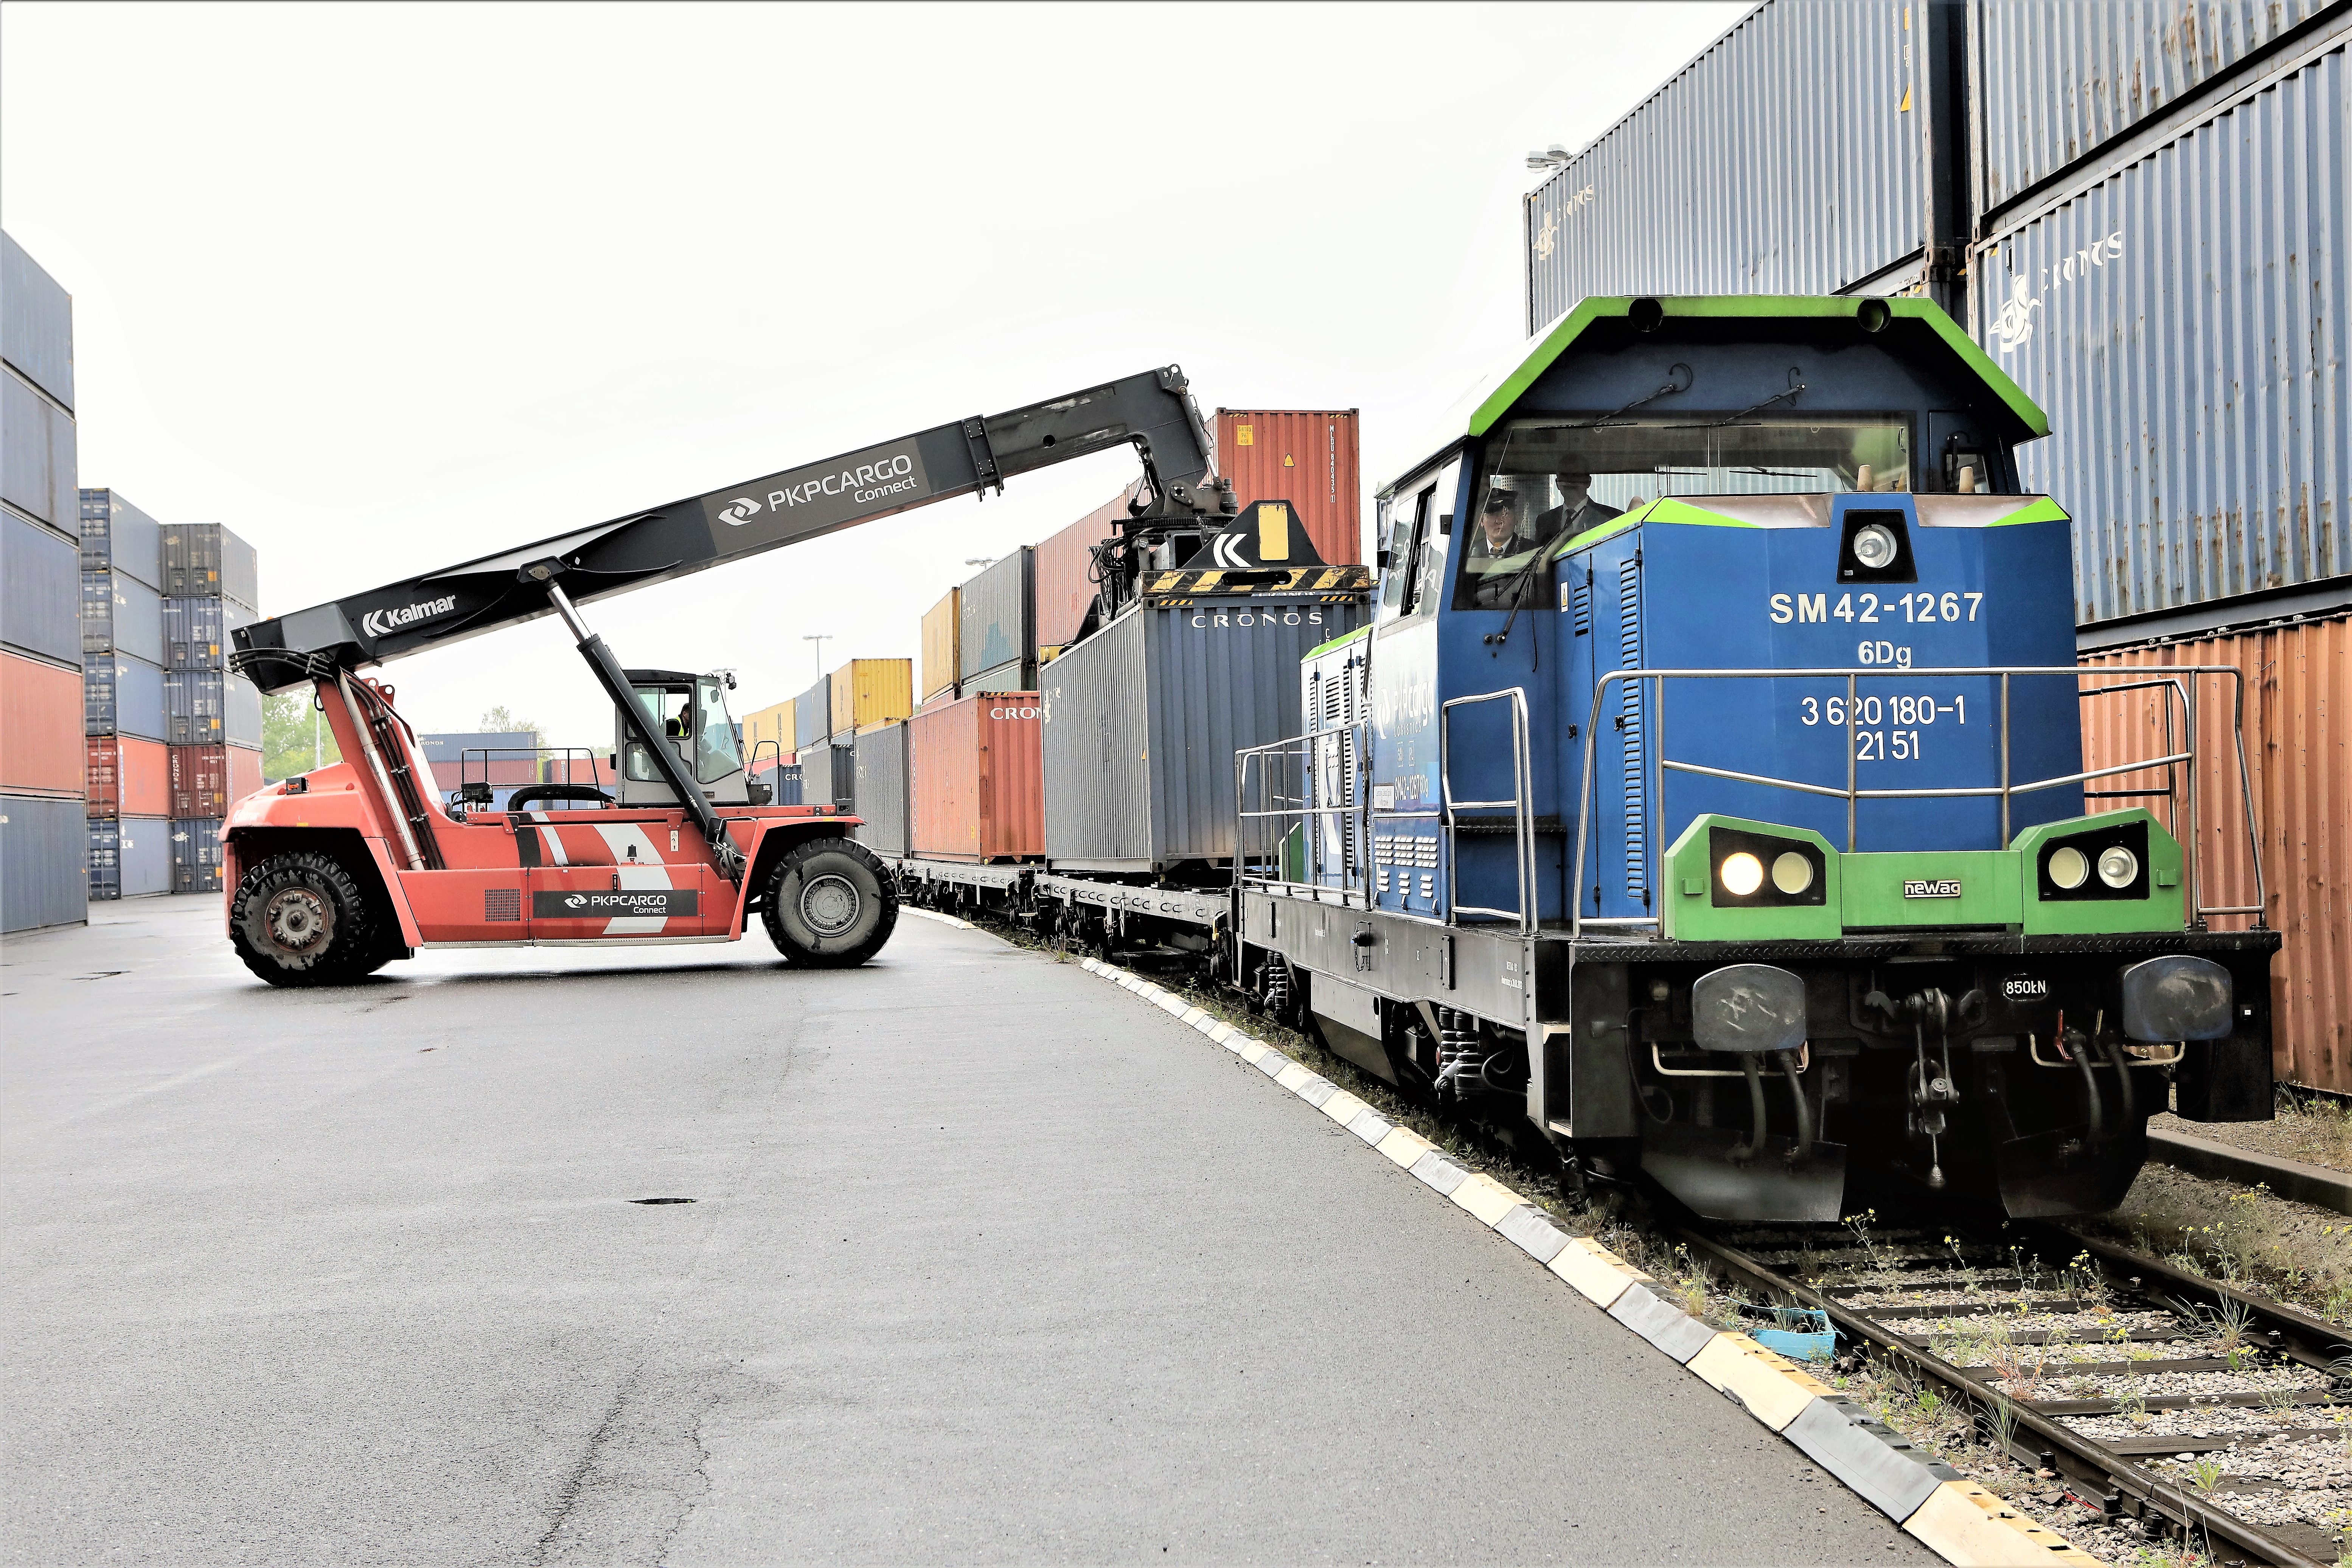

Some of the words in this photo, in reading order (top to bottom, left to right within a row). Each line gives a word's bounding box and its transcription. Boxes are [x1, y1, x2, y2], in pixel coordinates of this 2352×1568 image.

[767, 455, 912, 512] PKPCARGO
[854, 475, 917, 503] Connect
[386, 595, 456, 627] Kalmar
[1191, 612, 1323, 628] CRONOS
[1858, 640, 1912, 668] 6Dg
[1801, 696, 1819, 726] 3
[1826, 696, 1882, 726] 620
[1889, 694, 1965, 725] 180-1
[1394, 720, 1422, 737] LOGISTICS
[1856, 730, 1885, 761] 21
[1892, 730, 1920, 760] 51
[591, 895, 667, 906] PKPCARGO
[2006, 980, 2046, 994] 850kN
